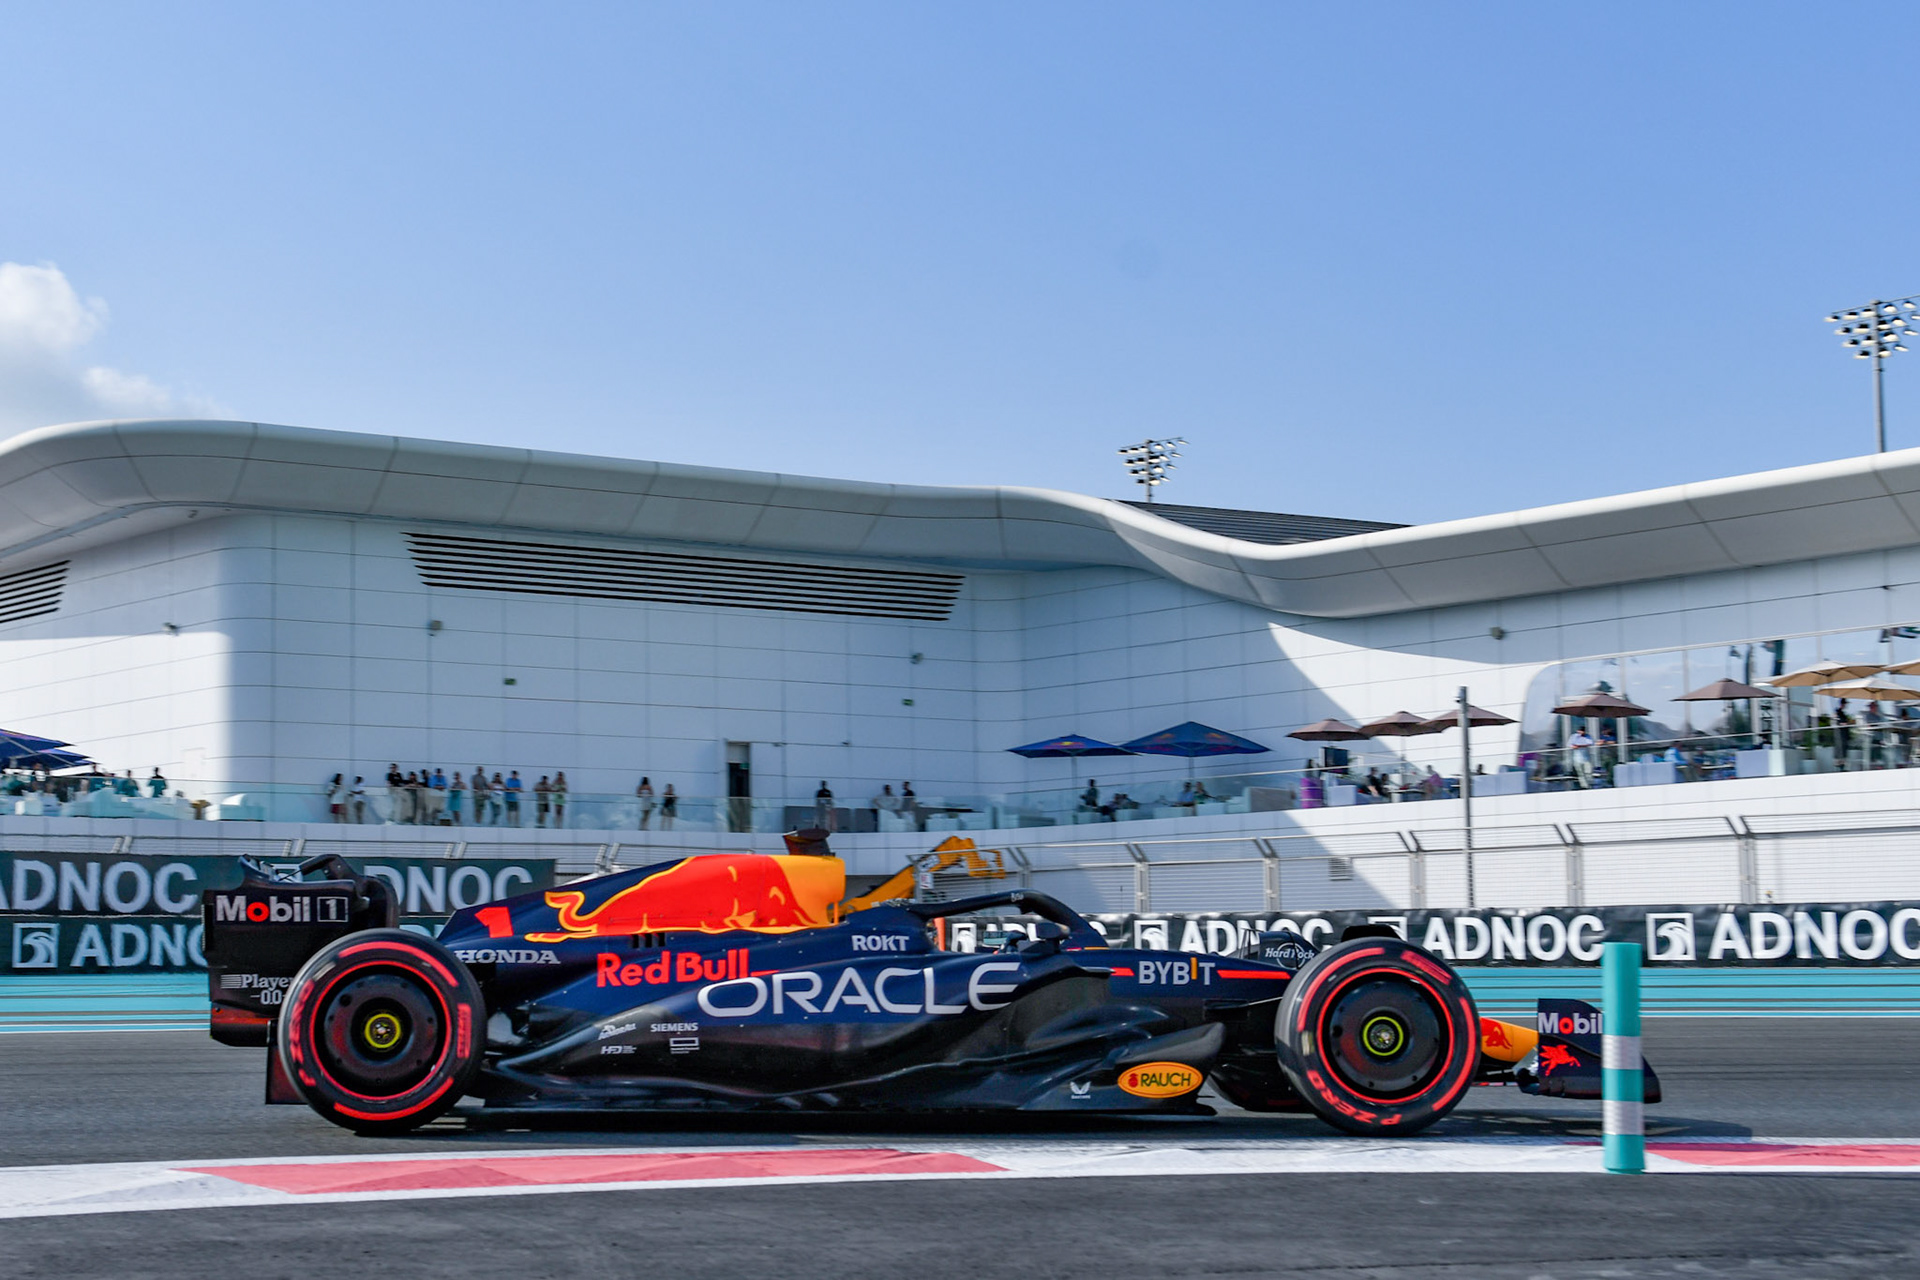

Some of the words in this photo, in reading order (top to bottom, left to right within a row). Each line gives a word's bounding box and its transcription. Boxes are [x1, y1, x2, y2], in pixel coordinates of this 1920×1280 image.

[0, 859, 198, 913] DNOC
[216, 895, 311, 922] Mobil
[475, 907, 514, 938] 1
[70, 923, 208, 967] ADN
[852, 935, 909, 951] ROKT
[1422, 914, 1605, 961] ADNOC
[454, 950, 561, 965] HONDA
[1265, 948, 1290, 958] Hard
[597, 951, 671, 988] Red
[676, 948, 749, 983] Bull
[1138, 957, 1216, 986] BYBIT
[697, 962, 1021, 1018] ORACLE
[650, 1022, 699, 1032] SIEMENS
[1538, 1012, 1602, 1035] Mobil
[1140, 1072, 1192, 1087] RAUCH
